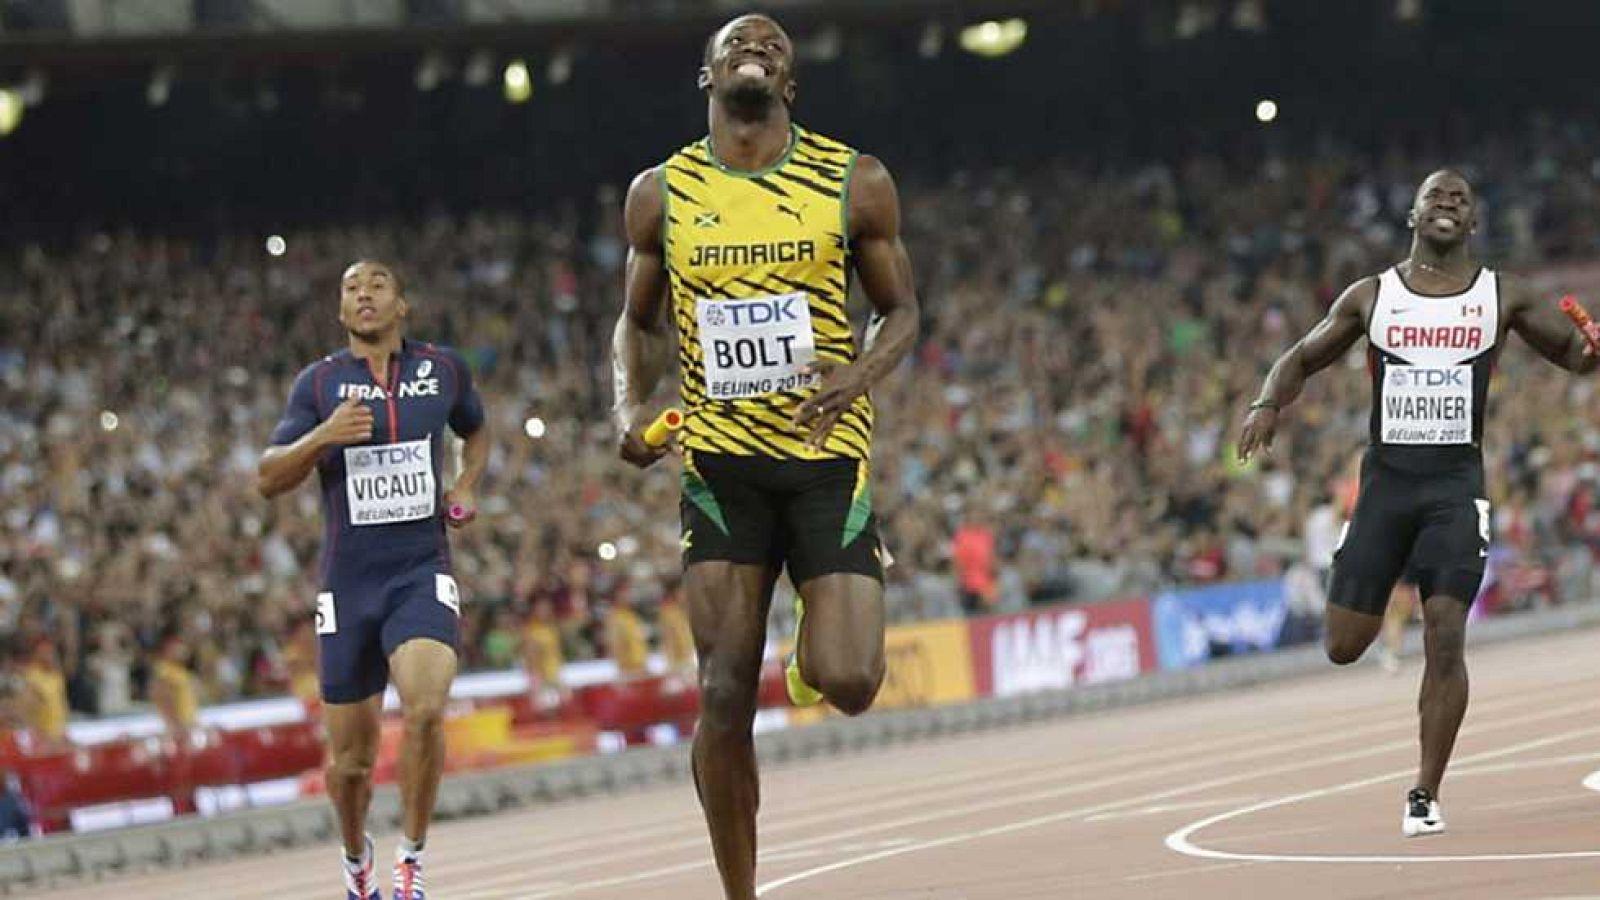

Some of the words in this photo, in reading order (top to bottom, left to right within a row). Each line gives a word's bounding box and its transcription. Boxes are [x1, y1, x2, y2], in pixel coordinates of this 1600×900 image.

[688, 240, 815, 266] JAMAICA
[724, 297, 798, 325] TDK
[1386, 326, 1482, 350] CANADA
[714, 335, 796, 369] BOLT
[712, 378, 772, 396] BEIJING
[1408, 368, 1463, 386] TDK
[1386, 396, 1466, 419] WARNER
[372, 445, 425, 466] TDK
[352, 472, 428, 500] VICAUT
